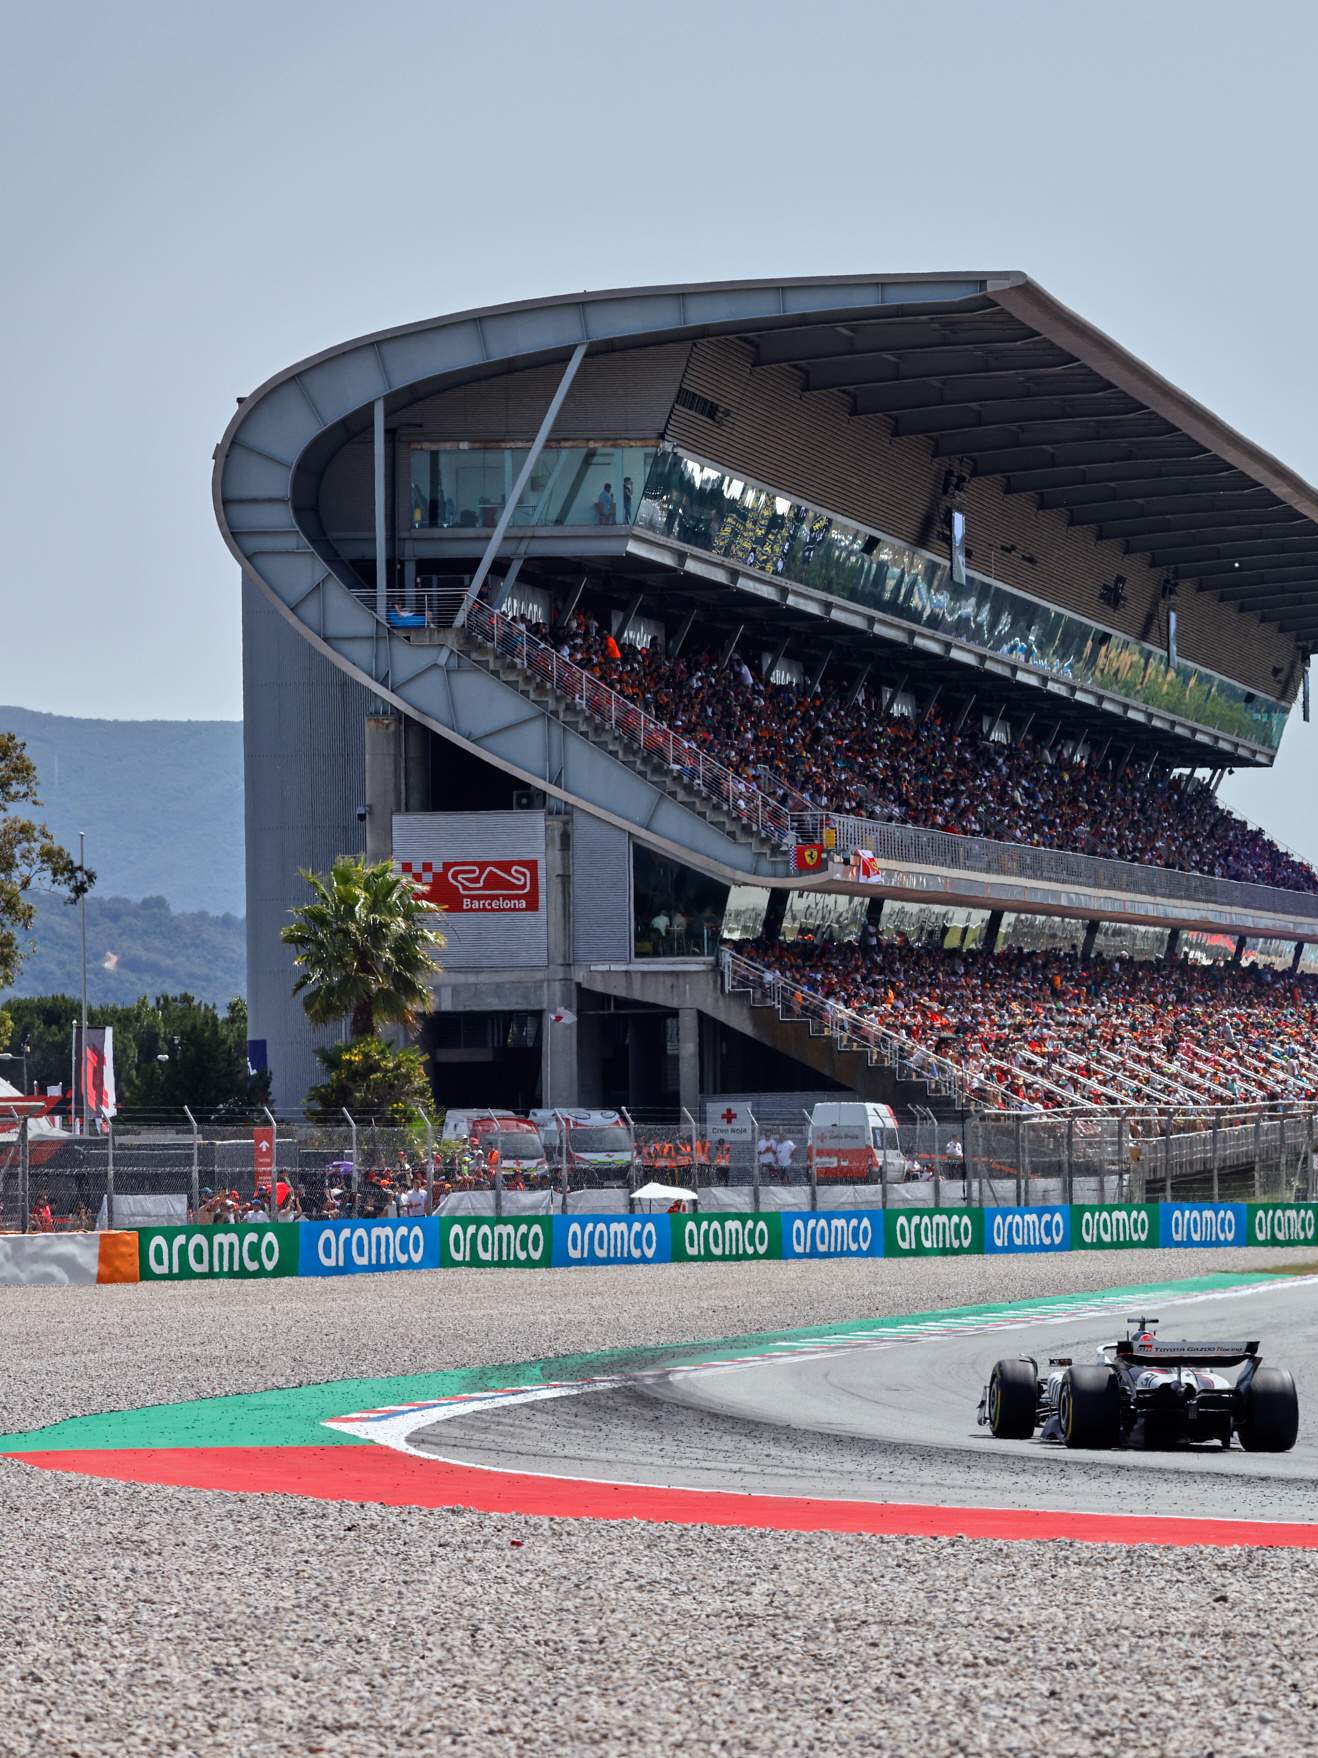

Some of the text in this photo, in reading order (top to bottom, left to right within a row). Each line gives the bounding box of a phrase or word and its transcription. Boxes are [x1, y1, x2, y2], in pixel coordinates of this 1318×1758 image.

[463, 897, 527, 910] Barcelona
[149, 1232, 280, 1274] aramco
[318, 1226, 424, 1267] aramco
[449, 1224, 543, 1262] aramco
[568, 1222, 656, 1259] aramco
[685, 1220, 768, 1256] aramco
[793, 1217, 871, 1253] aramco
[896, 1215, 972, 1249] aramco
[994, 1213, 1063, 1246] aramco
[1082, 1210, 1148, 1243] aramco
[1172, 1210, 1236, 1241] aramco
[1255, 1209, 1314, 1240] aramco
